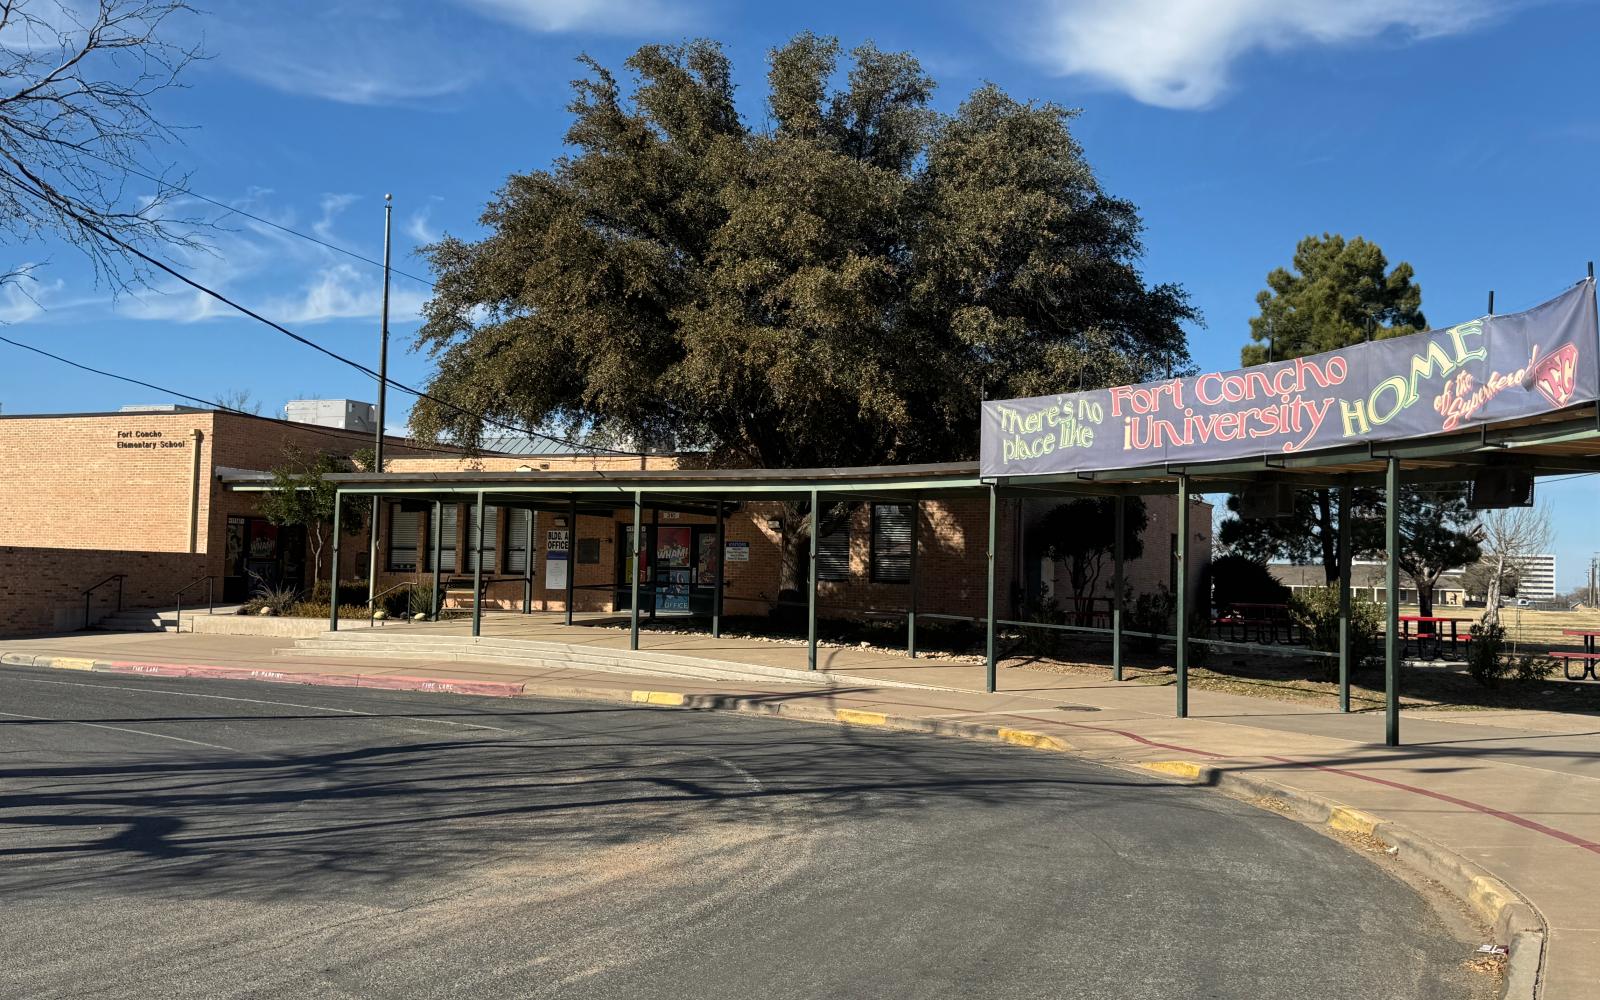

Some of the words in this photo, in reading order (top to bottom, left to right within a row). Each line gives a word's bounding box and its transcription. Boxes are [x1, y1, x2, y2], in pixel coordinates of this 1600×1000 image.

[1109, 378, 1184, 417] Fort
[1195, 356, 1347, 405] Concho
[1339, 320, 1487, 438] HOME
[1433, 379, 1454, 417] of
[1455, 369, 1475, 398] the
[135, 430, 162, 438] Concho
[997, 396, 1074, 434] There's
[1078, 399, 1104, 424] no
[1123, 394, 1335, 453] iUniversity
[116, 441, 157, 449] Elementary
[1003, 432, 1056, 464] place
[1058, 416, 1094, 449] like
[547, 531, 563, 540] BLDG.
[564, 531, 569, 540] A
[547, 541, 569, 550] OFFICE
[656, 547, 689, 559] WHAM!
